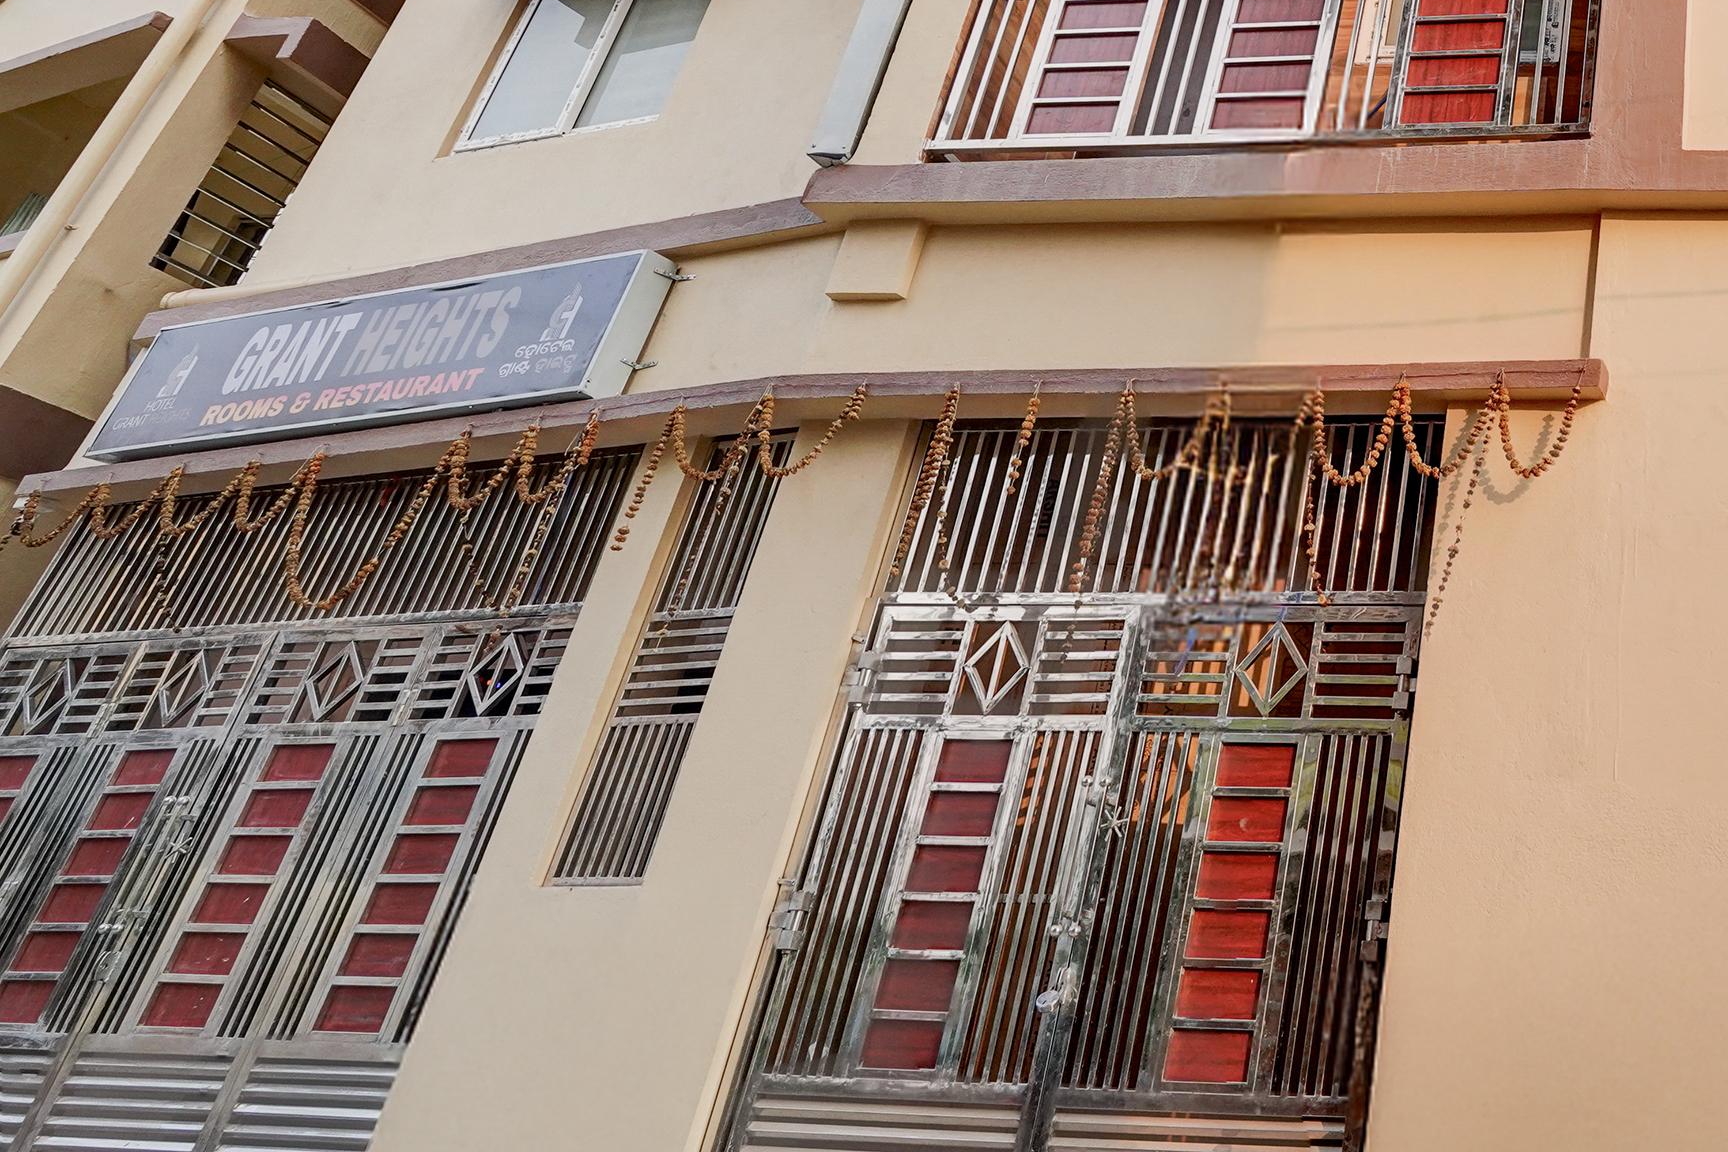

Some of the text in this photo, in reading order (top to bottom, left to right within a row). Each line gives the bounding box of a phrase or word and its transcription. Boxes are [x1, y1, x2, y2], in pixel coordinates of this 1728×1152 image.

[222, 286, 522, 395] GRANT HEIGHTS
[144, 398, 176, 411] HOTEL
[200, 395, 287, 426] ROOMS
[289, 392, 312, 413] &
[313, 367, 485, 411] RESTAURANT
[112, 414, 150, 430] GRANT
